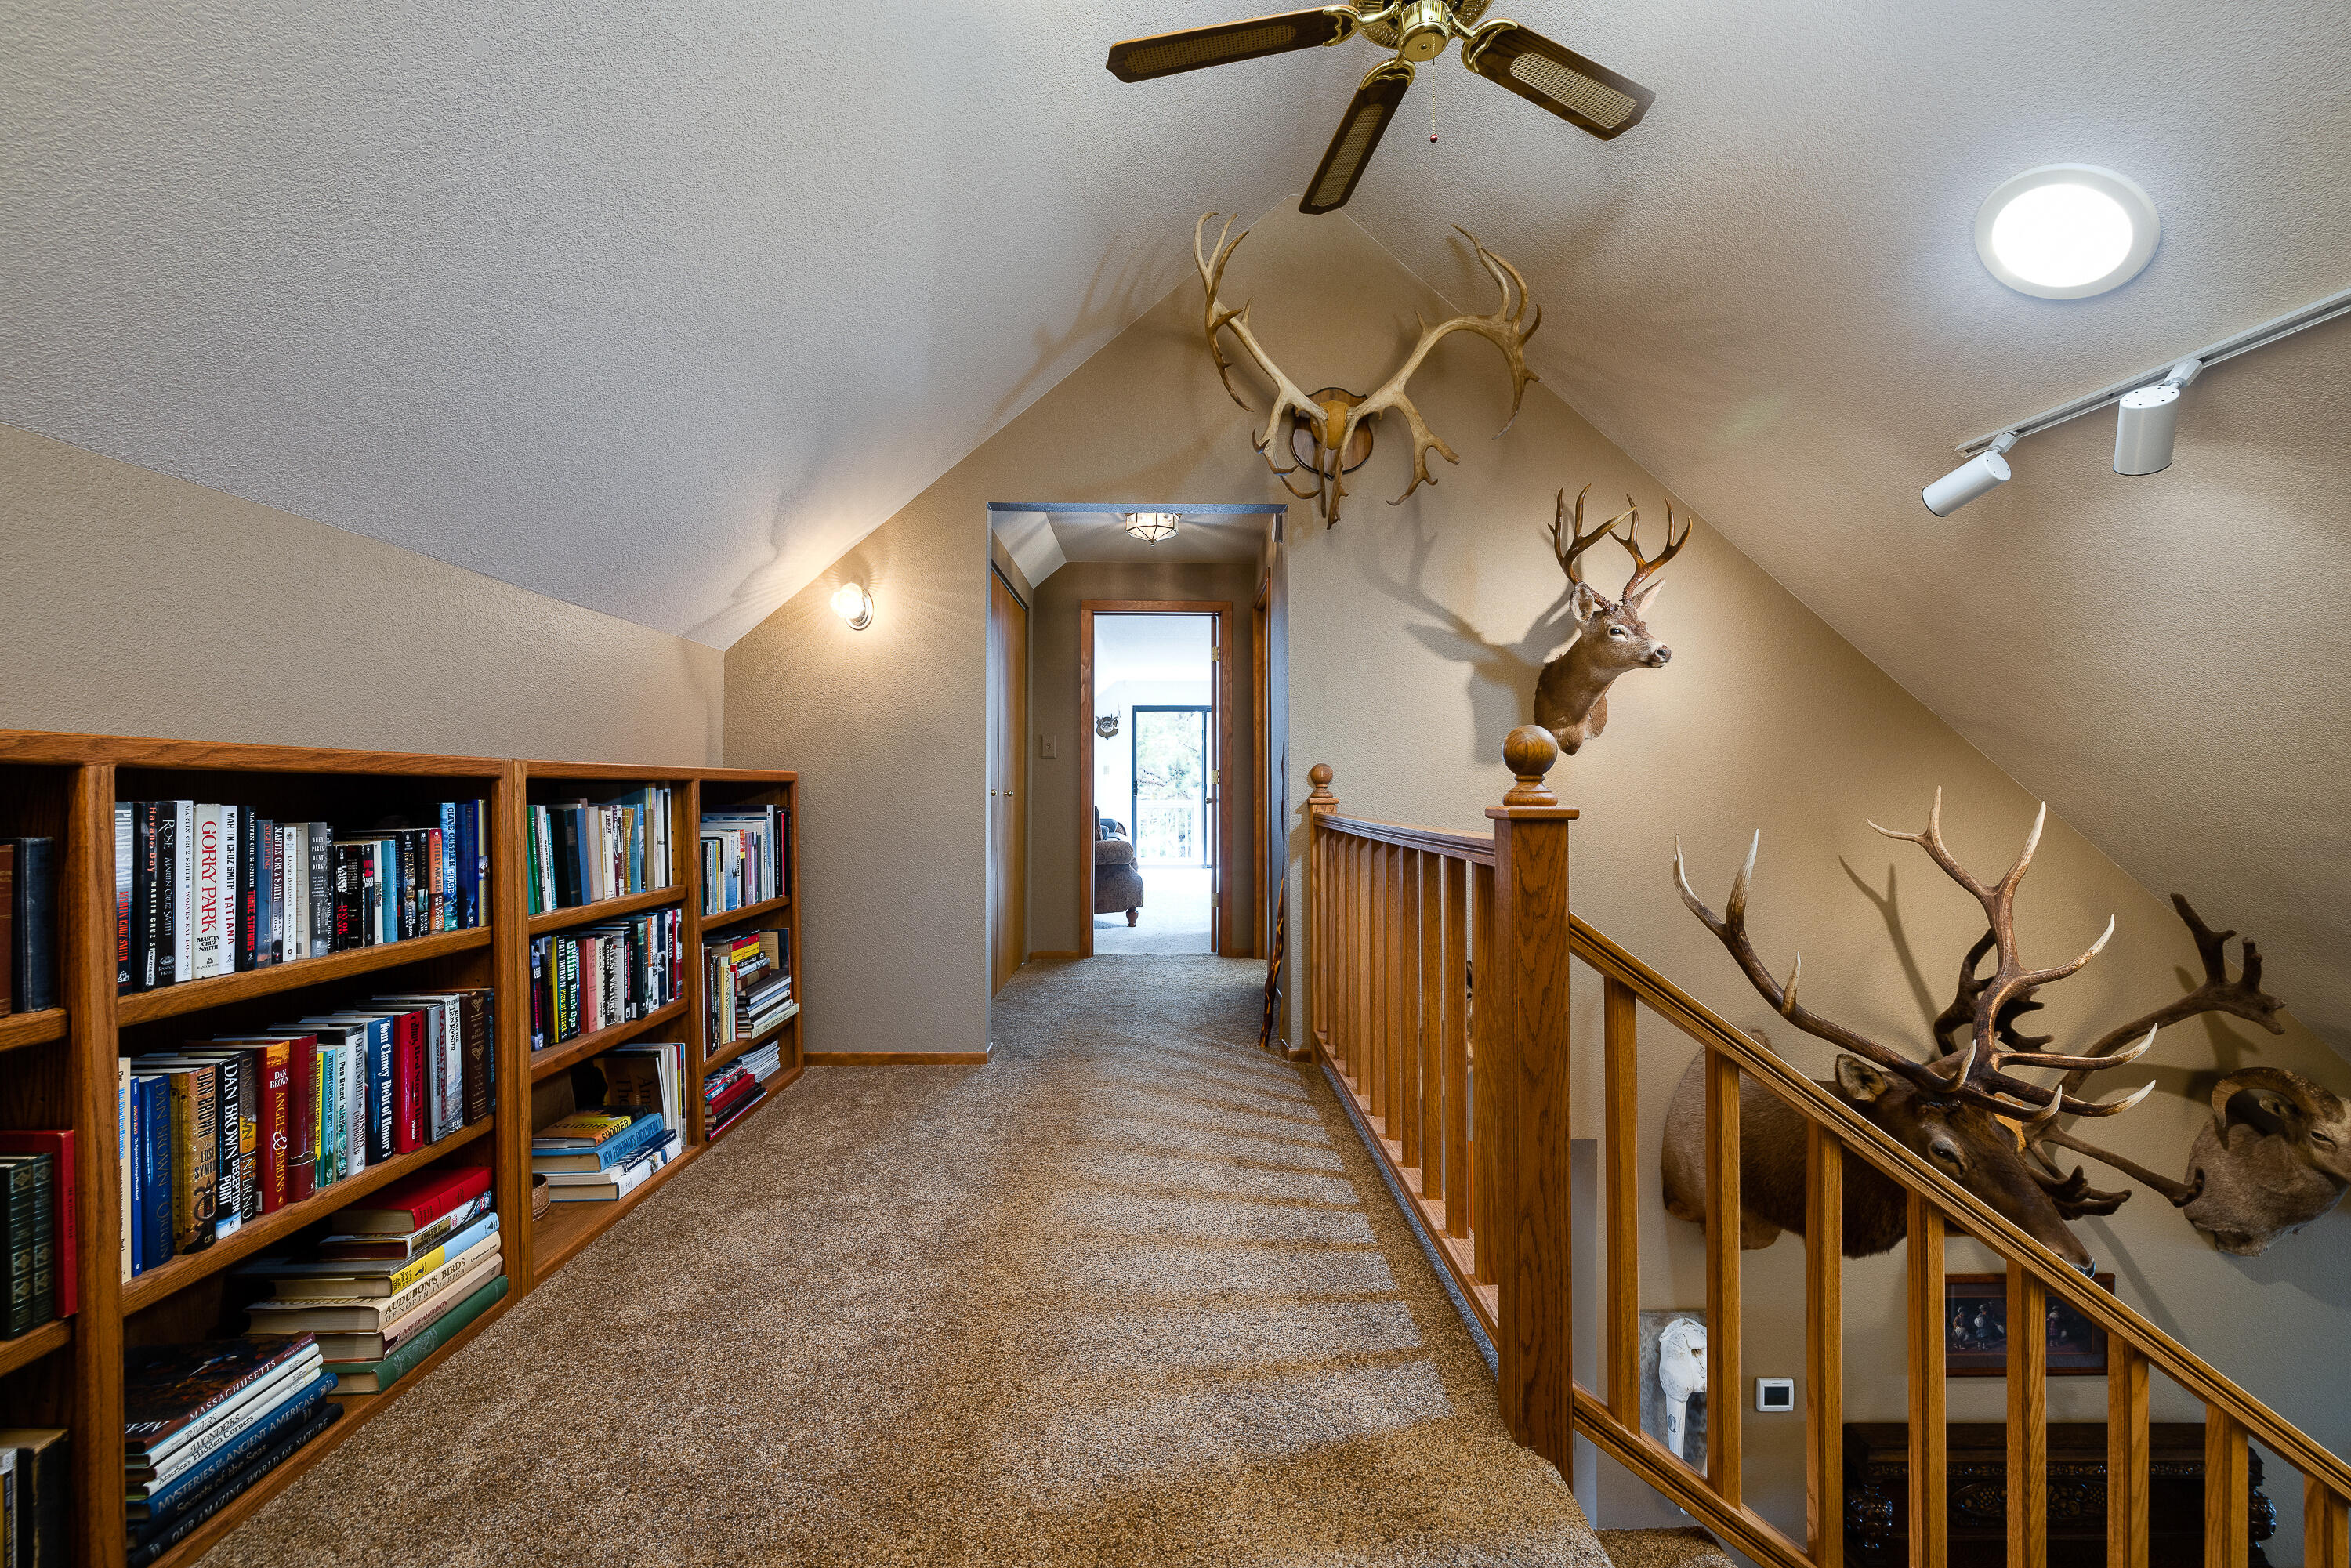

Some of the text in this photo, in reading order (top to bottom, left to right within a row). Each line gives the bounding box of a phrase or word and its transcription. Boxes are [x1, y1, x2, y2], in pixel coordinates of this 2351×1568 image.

[158, 820, 175, 850] ROSE
[226, 812, 235, 842] MARTIN
[226, 844, 235, 864] CRUZ
[147, 853, 157, 873] Bay
[201, 820, 217, 934] GORKY PARK
[273, 827, 283, 903] MARTIN CRUZ SMITH
[119, 891, 129, 961] MARTIN CRUZ SMITH
[163, 911, 172, 936] SMITH
[224, 894, 235, 945] TATIANA
[247, 890, 255, 951] THREE STATIONS
[567, 940, 576, 981] Griffin
[568, 1011, 578, 1028] Ops
[270, 1076, 288, 1089] BROWN
[274, 1068, 287, 1080] DAN
[354, 1037, 364, 1101] OLIVER NORTH
[377, 1020, 392, 1150] Tom Clancy Debt of Honor
[197, 1071, 215, 1139] DAN BROWN
[224, 1062, 239, 1161] DAN BROWN
[241, 1058, 253, 1141] DAN BROWN
[200, 1146, 215, 1164] LOST
[273, 1092, 288, 1193] ANGELS & DEMONS
[601, 1119, 629, 1140] SHOOTER
[602, 1120, 659, 1165] NEW FISHERMAN'S ENCYCLOPEDIA
[155, 1082, 170, 1259] DAN BROWN ORIGIN
[219, 1174, 232, 1205] POINT
[231, 1157, 241, 1214] DECEPTION
[240, 1150, 256, 1219] INFERNO
[385, 1275, 438, 1316] AUDUBON'S
[441, 1258, 465, 1280] BIRDS
[386, 1312, 397, 1324] OF
[399, 1291, 429, 1316] NORTH
[431, 1268, 465, 1295] AMERICA
[189, 1360, 276, 1421] MASSACHUSETTS
[158, 1459, 191, 1486] America's
[193, 1436, 223, 1461] Hidden
[223, 1414, 254, 1439] Corners
[158, 1465, 216, 1513] MYSTERIES
[226, 1426, 268, 1462] ANCIENT
[269, 1393, 315, 1434] AMERICAS
[185, 1412, 218, 1441] RIVERS
[189, 1414, 240, 1454] WONDERS
[171, 1519, 194, 1543] OUR
[197, 1482, 244, 1522] AMAZING
[247, 1455, 280, 1485] WORLD
[281, 1443, 294, 1458] OF
[295, 1417, 328, 1446] NATURE
[176, 1485, 212, 1515] Secrets
[214, 1472, 225, 1487] of
[227, 1461, 244, 1478] the
[245, 1443, 266, 1460] Seas
